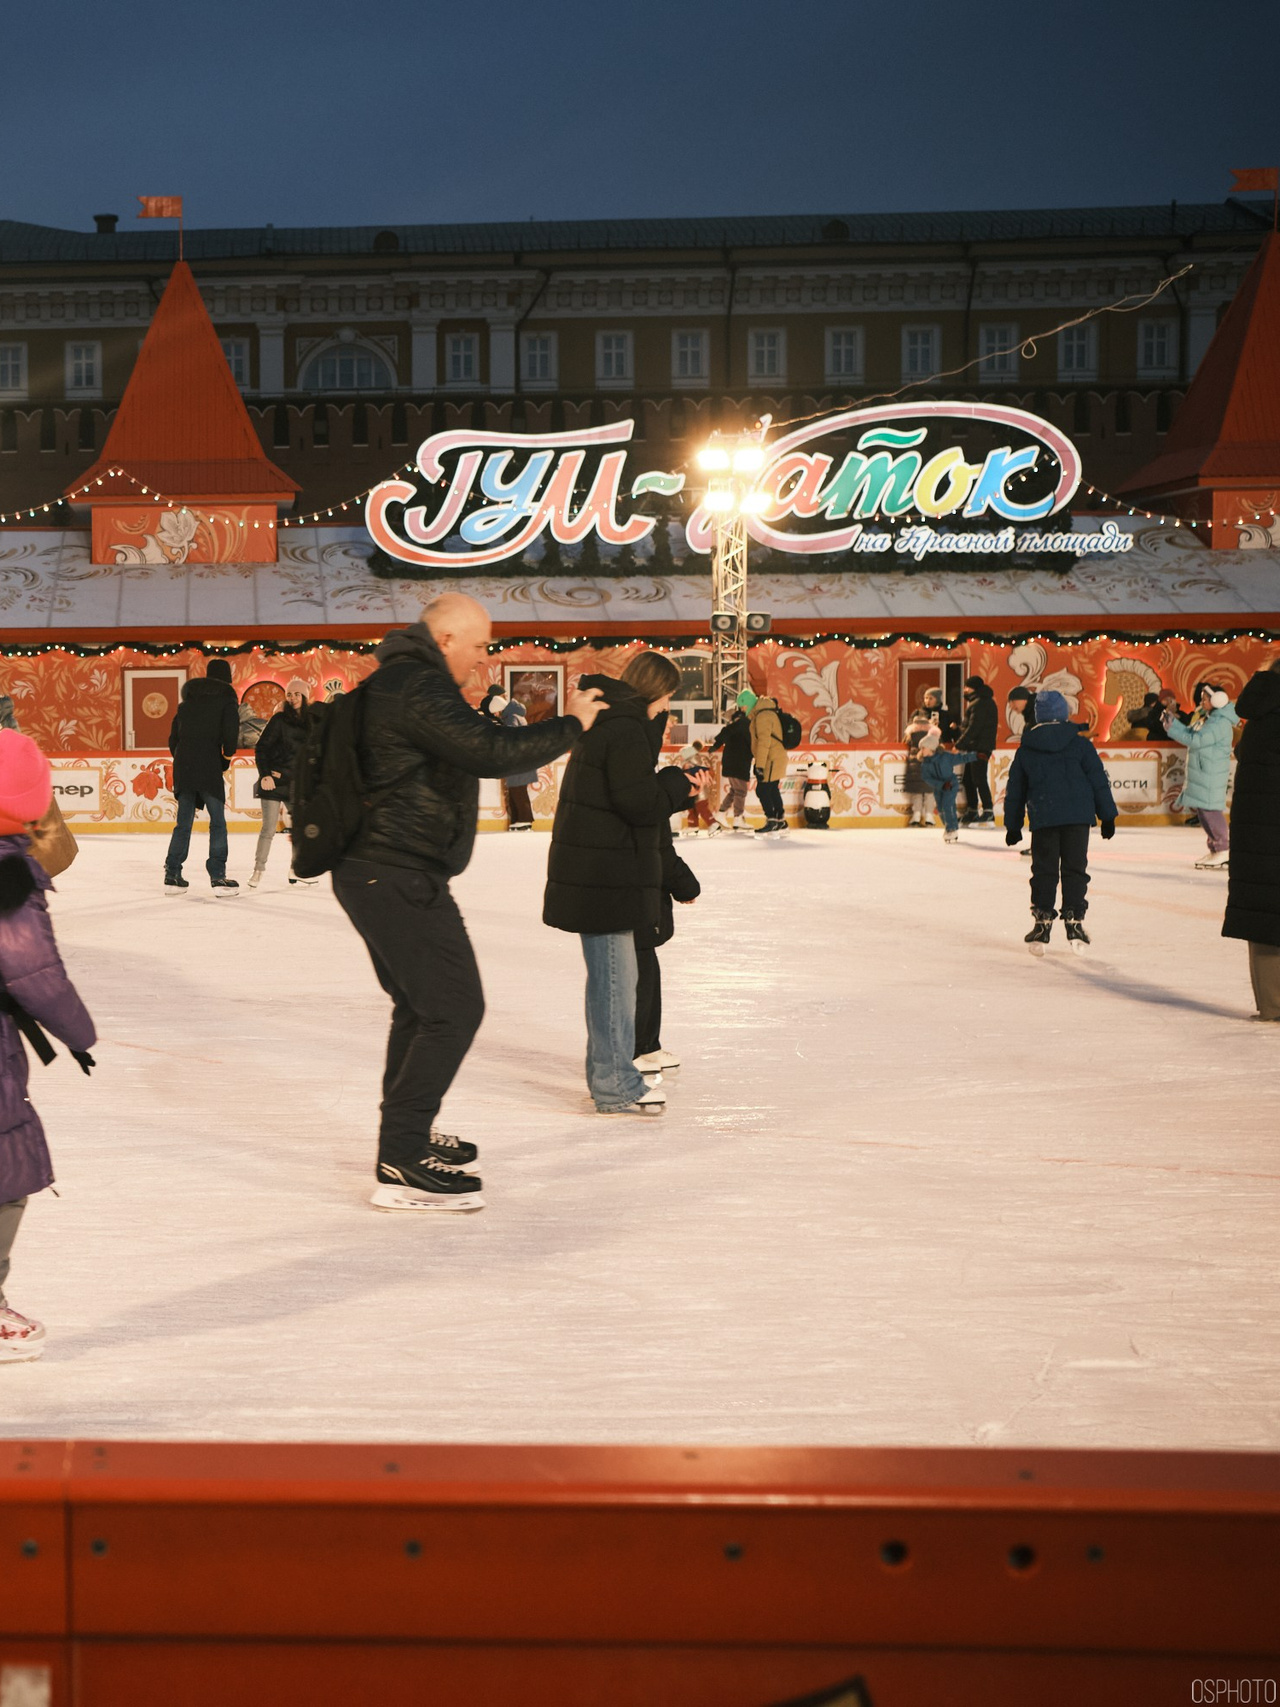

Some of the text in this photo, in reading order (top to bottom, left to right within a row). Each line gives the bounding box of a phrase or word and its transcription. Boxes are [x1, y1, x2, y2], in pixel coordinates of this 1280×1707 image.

[854, 521, 1134, 561] на Красной площади
[52, 785, 94, 798] пер
